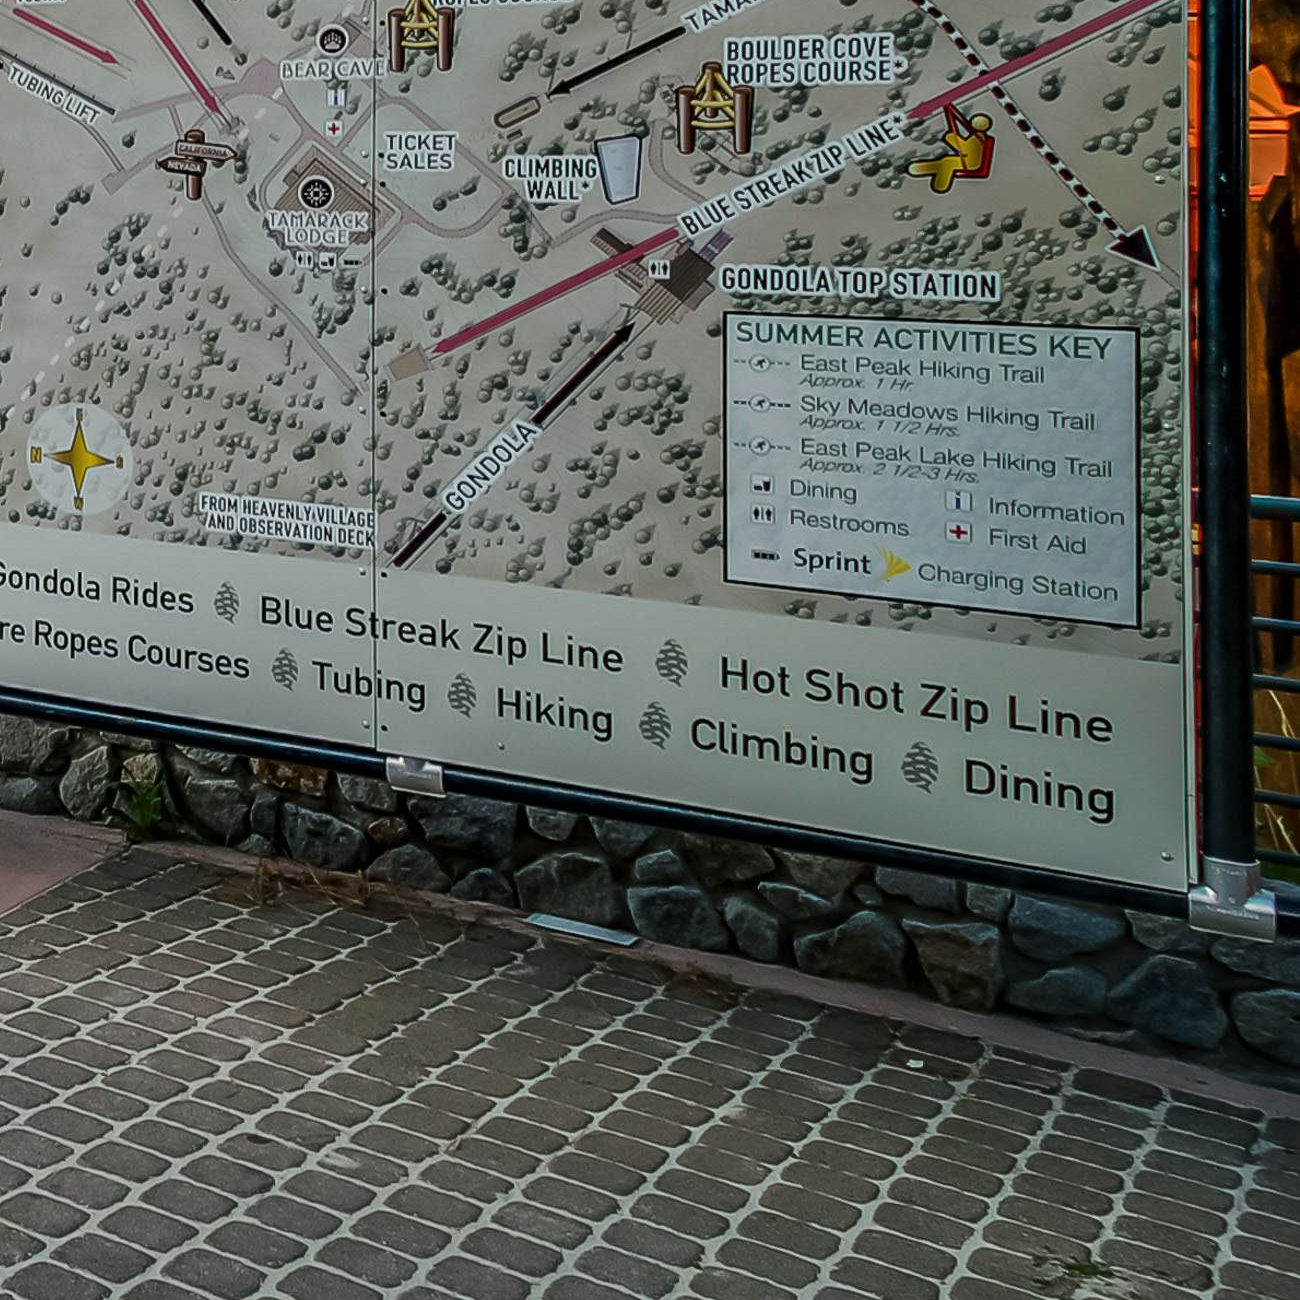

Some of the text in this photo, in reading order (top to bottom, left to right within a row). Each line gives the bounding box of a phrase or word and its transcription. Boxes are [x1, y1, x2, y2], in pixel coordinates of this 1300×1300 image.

[727, 36, 890, 62] BOULDER COVE
[282, 60, 385, 78] BEAR CAVE
[728, 61, 795, 83] ROPES
[10, 66, 100, 123] TUBING LIFT
[178, 144, 229, 158] CALIFORNIA
[386, 134, 456, 151] TICKET
[167, 160, 202, 173] NEVADA
[386, 153, 452, 169] SALES
[505, 159, 598, 179] CLIMBING
[681, 197, 735, 235] BLUE
[734, 159, 812, 210] STREAK
[813, 145, 844, 174] ZIP
[269, 211, 367, 229] TAMARACK
[286, 229, 348, 244] LODGE
[722, 267, 996, 298] GONDOLA TOP STATION
[736, 321, 1113, 360] SUMMER ACTIVITIES KEY
[800, 374, 864, 390] Approx.
[801, 355, 1045, 384] East Peak Hiking Trail
[800, 396, 1095, 431] Sky Meadows Hiking Trail
[800, 415, 864, 431] Approx.
[925, 422, 960, 438] Hrs.
[446, 423, 537, 510] GONDOLA
[800, 438, 1112, 478] East Peak Lake Hiking Trail
[800, 457, 866, 475] Approx.
[873, 462, 886, 476] 2
[944, 467, 981, 484] Hrs.
[790, 478, 858, 504] Dining
[201, 495, 375, 529] FROM HEAVENLY VILLAGE
[790, 509, 910, 537] Restrooms
[989, 496, 1126, 526] Information
[207, 514, 375, 547] AND OBSERVATION DECK
[989, 528, 1088, 555] First Aid
[793, 547, 1119, 602] Sprint Charging Station
[111, 576, 194, 613] Rides
[261, 596, 334, 633] Blue
[345, 607, 461, 651] Streak
[472, 622, 528, 666] Zip
[542, 632, 624, 673] Line
[720, 656, 791, 698] Hot
[804, 667, 904, 714] Shot
[920, 682, 990, 733] Zip
[1008, 694, 1113, 743] Line
[35, 619, 119, 659] Ropes
[128, 635, 250, 679] Courses
[312, 660, 427, 713] Tubing
[497, 687, 614, 743] Hiking
[690, 717, 874, 786] Climbing
[965, 758, 1114, 825] Dining
